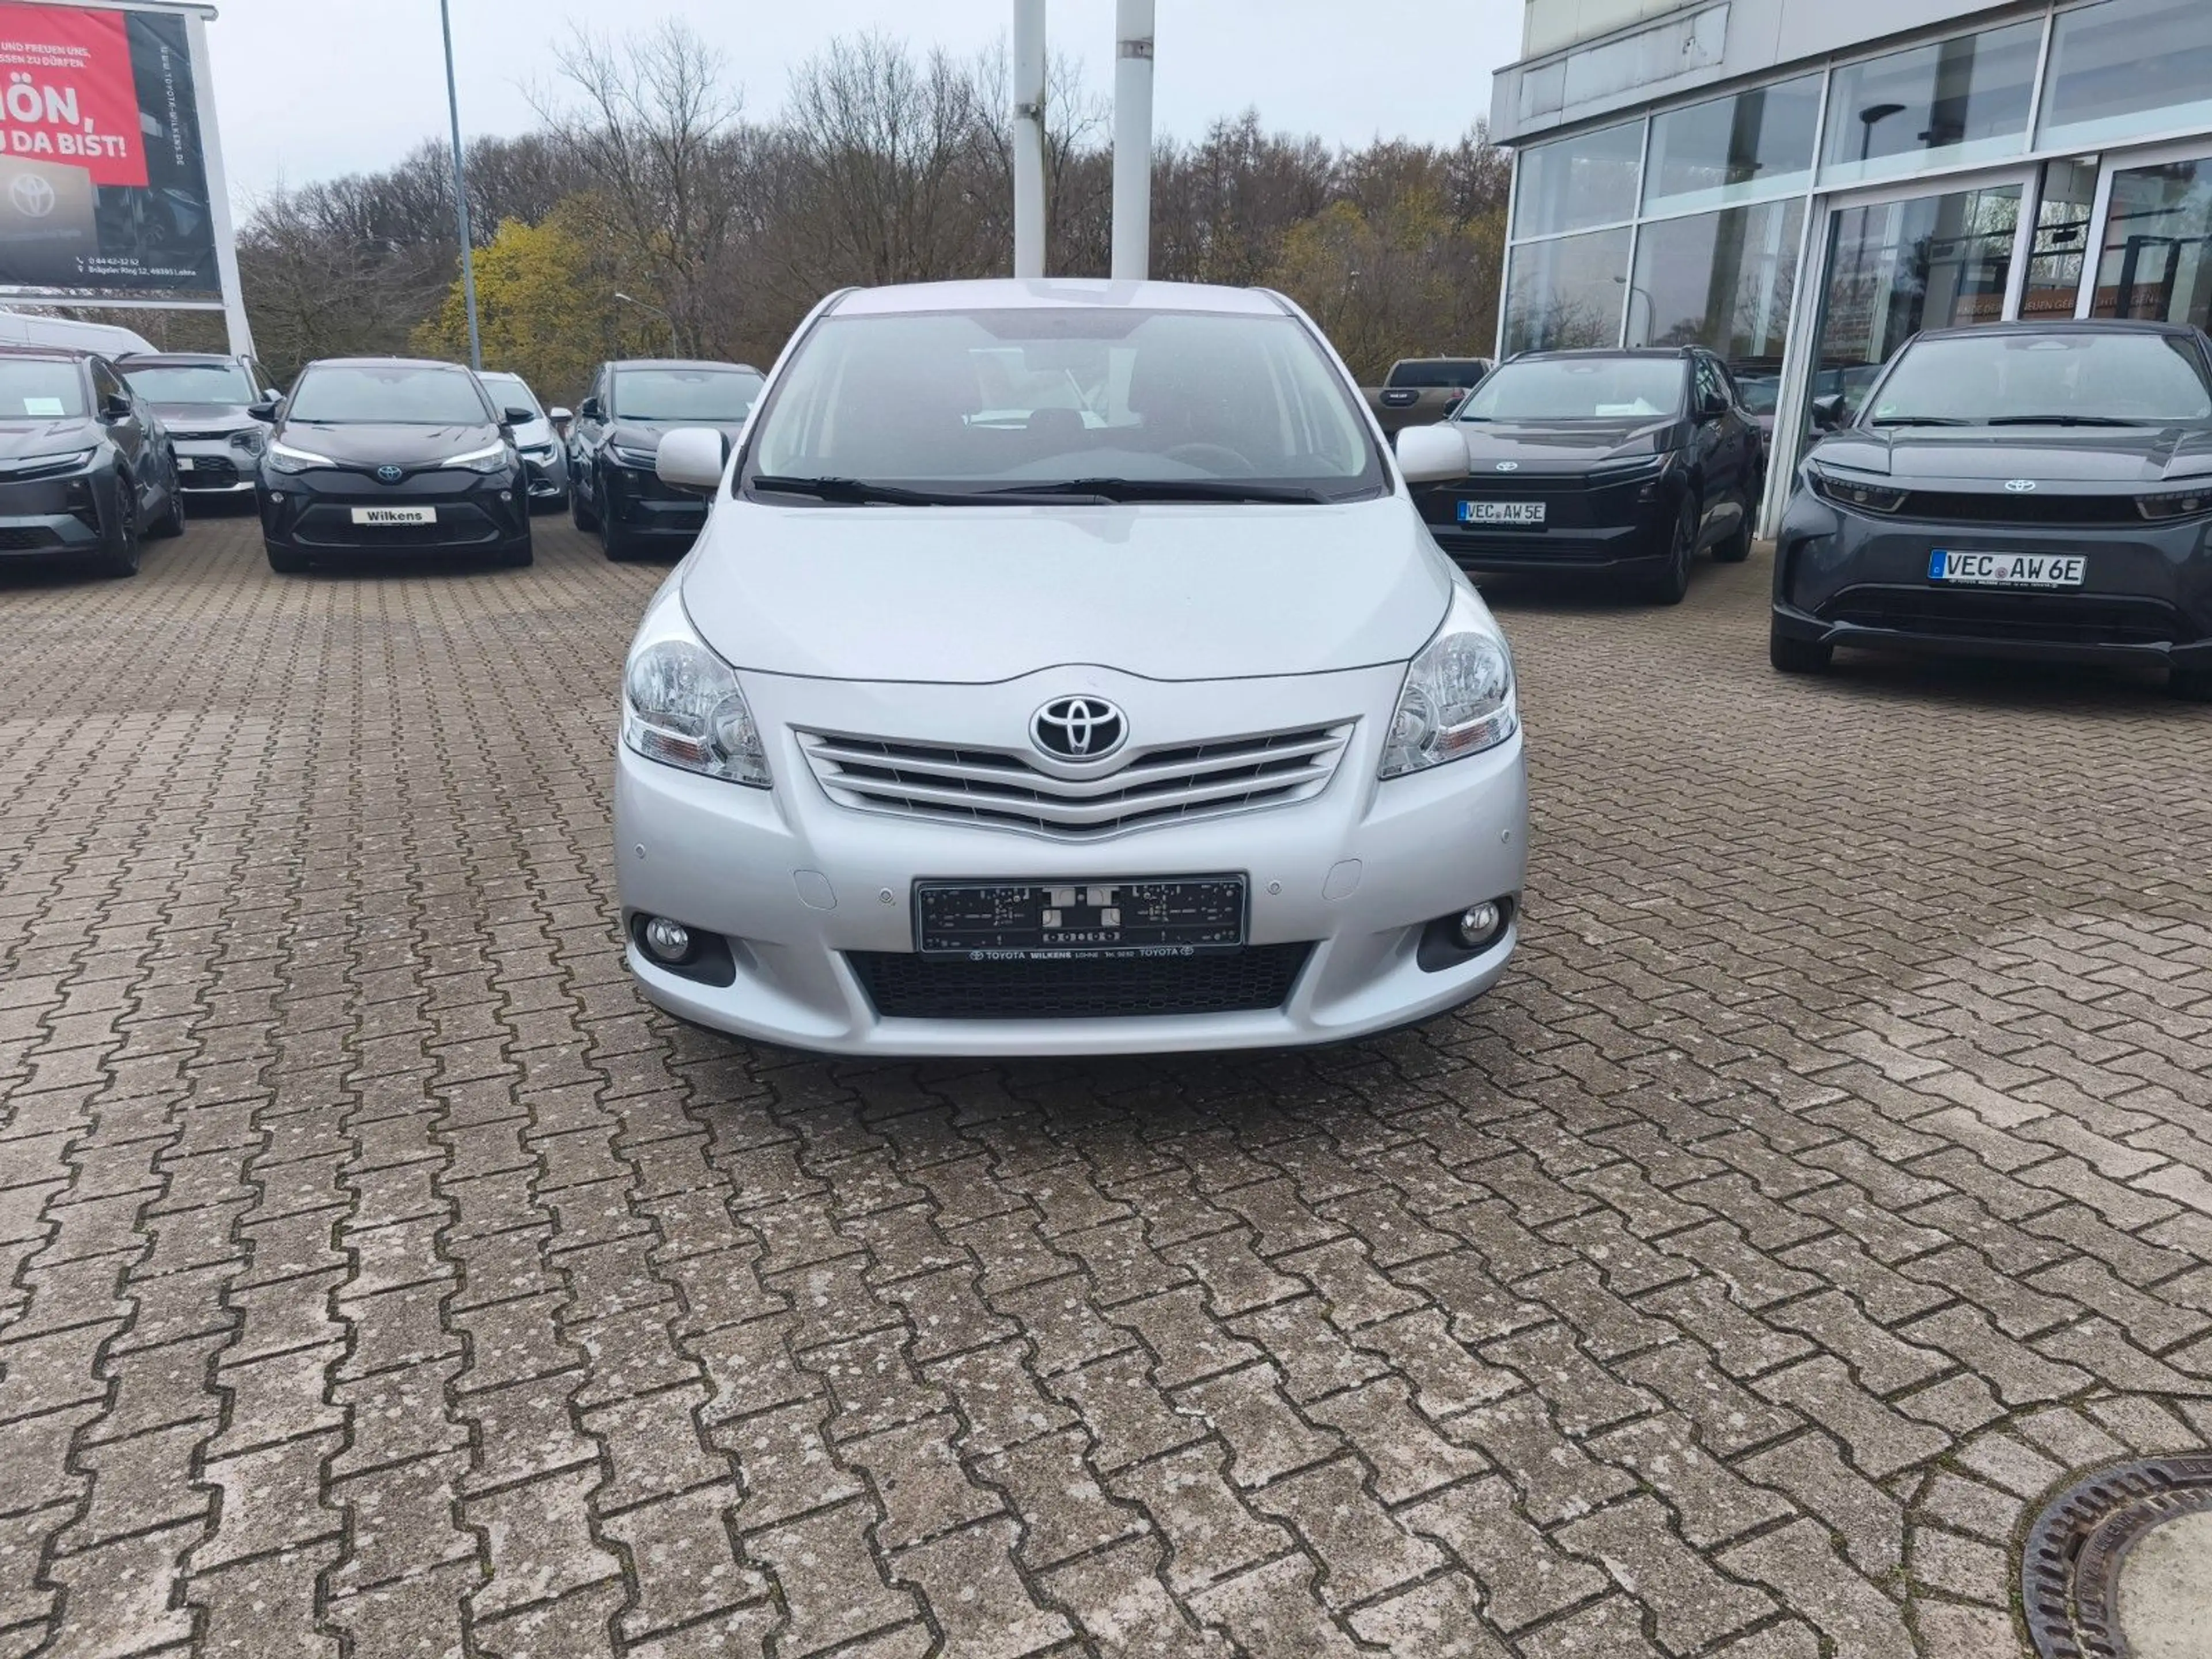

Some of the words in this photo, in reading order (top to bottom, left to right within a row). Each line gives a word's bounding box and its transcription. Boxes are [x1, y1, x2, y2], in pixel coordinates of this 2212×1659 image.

[1, 41, 24, 51] UND
[25, 44, 65, 55] FREUEN
[27, 56, 41, 64] ZU
[41, 55, 86, 67] DÜRFEN.
[0, 71, 94, 133] ÖN,
[12, 130, 53, 153] DA
[57, 133, 127, 157] BIST!
[367, 511, 423, 521] Wilkens
[1468, 504, 1494, 517] VEC
[1503, 505, 1522, 518] AW
[1525, 506, 1543, 519] 5E
[1948, 555, 1993, 575] VEC
[2010, 556, 2044, 578] AW
[2048, 559, 2081, 581] 6E
[986, 952, 1025, 960] TOYOTA
[1139, 948, 1179, 957] TOYOTA
